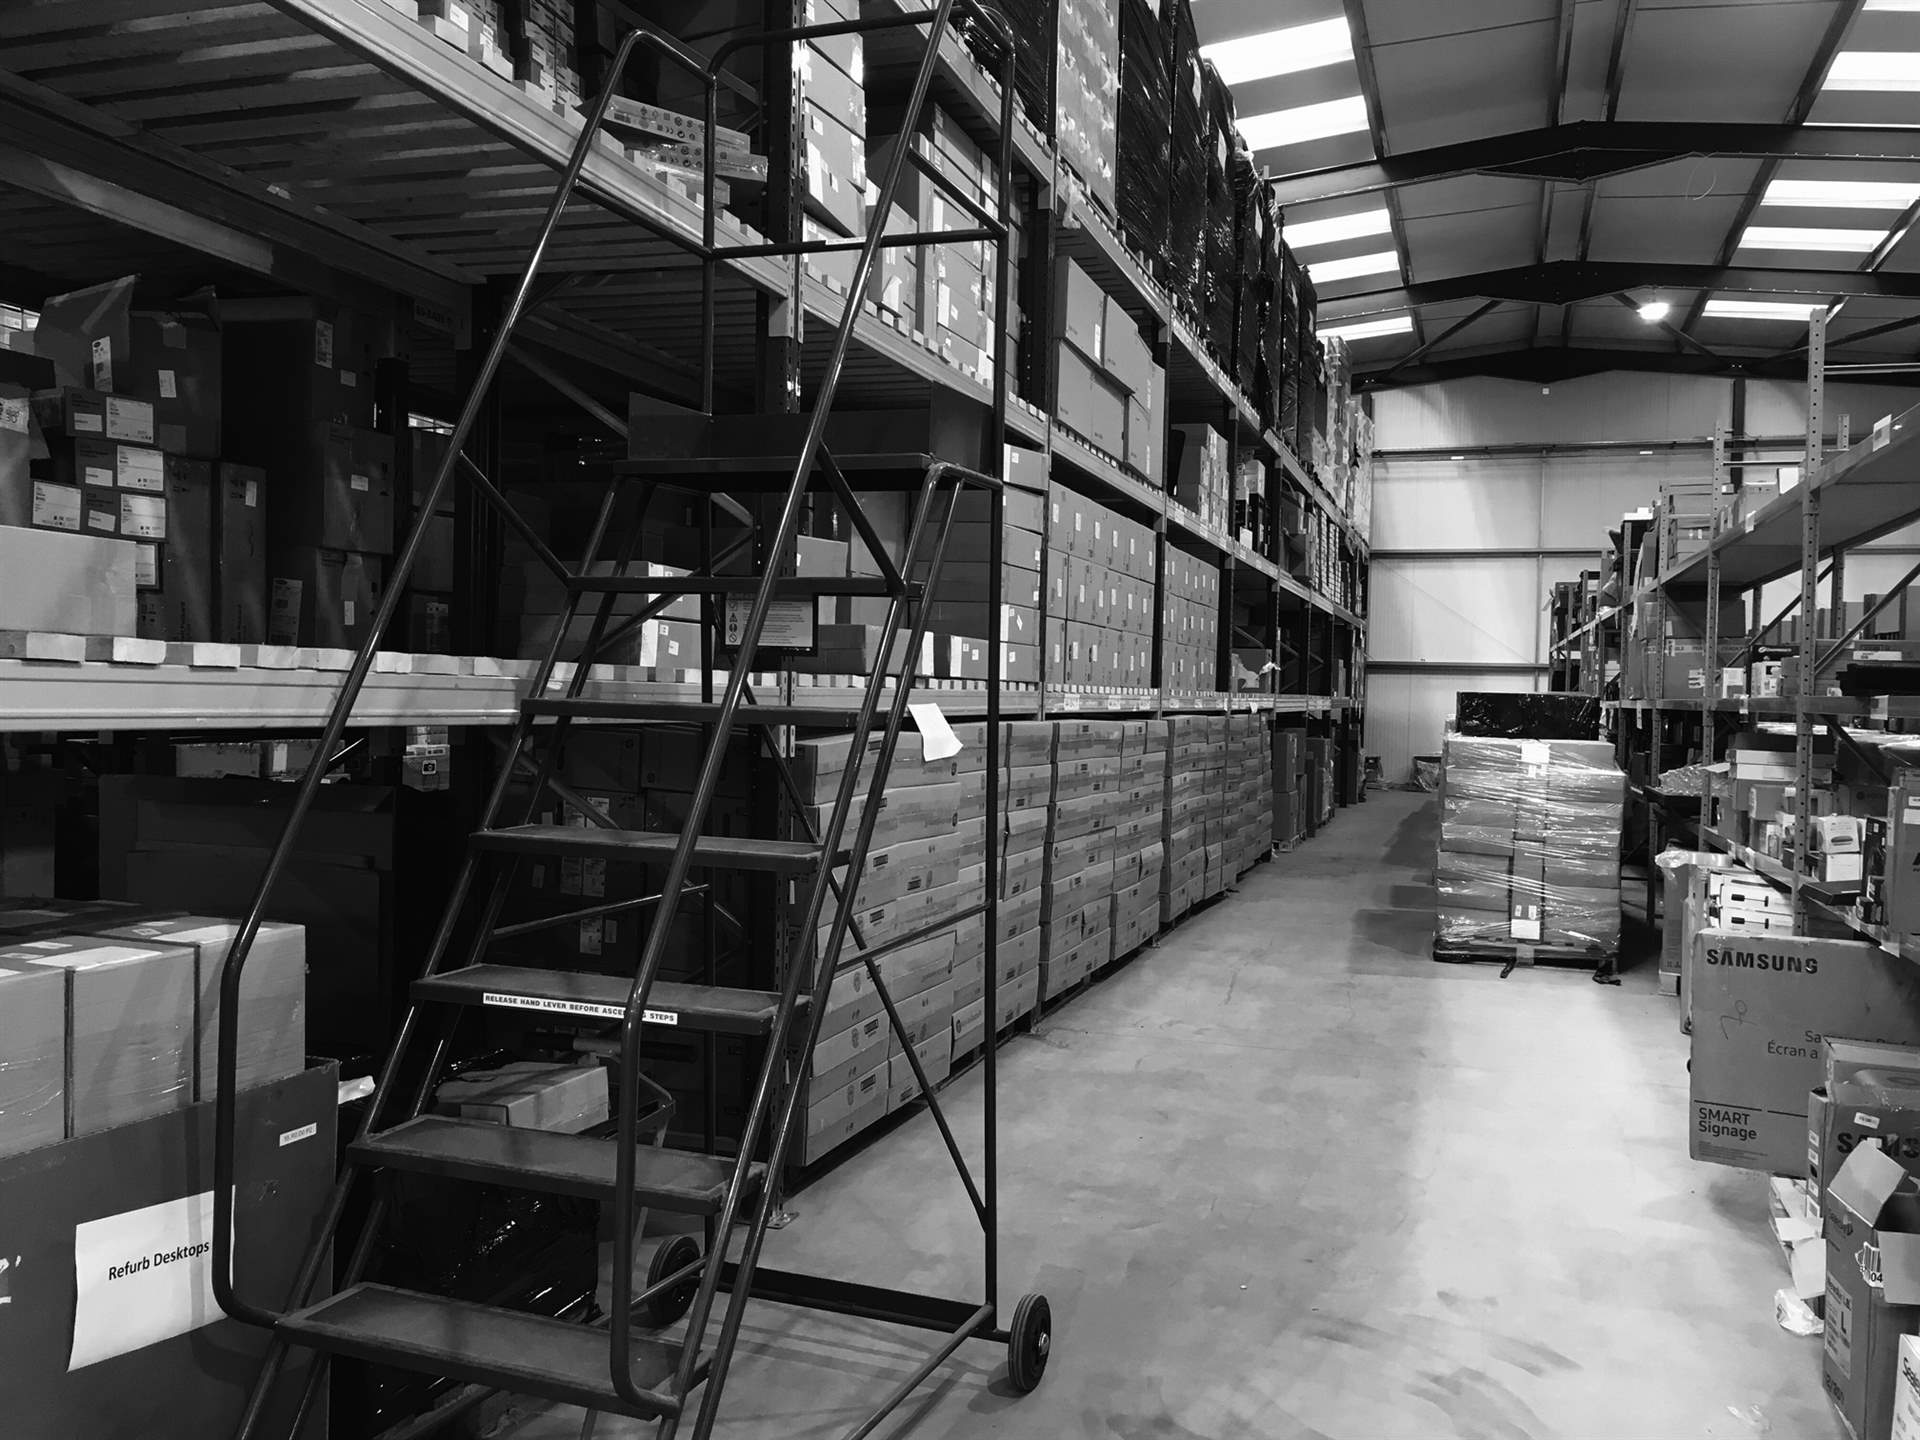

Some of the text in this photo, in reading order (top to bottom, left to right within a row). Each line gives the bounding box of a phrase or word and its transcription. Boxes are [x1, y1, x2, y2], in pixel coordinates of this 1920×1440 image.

[1706, 949, 1818, 974] SAMSUNG
[485, 995, 517, 1004] RELEASE
[520, 998, 540, 1007] HAND
[543, 1001, 567, 1009] LEVER
[569, 1004, 599, 1013] BEFORE
[650, 1012, 675, 1022] STEPS
[1767, 1039, 1806, 1057] Écran
[1698, 1107, 1751, 1126] SMART
[1698, 1121, 1757, 1141] Signage
[108, 1242, 209, 1280] Refurb Desktops
